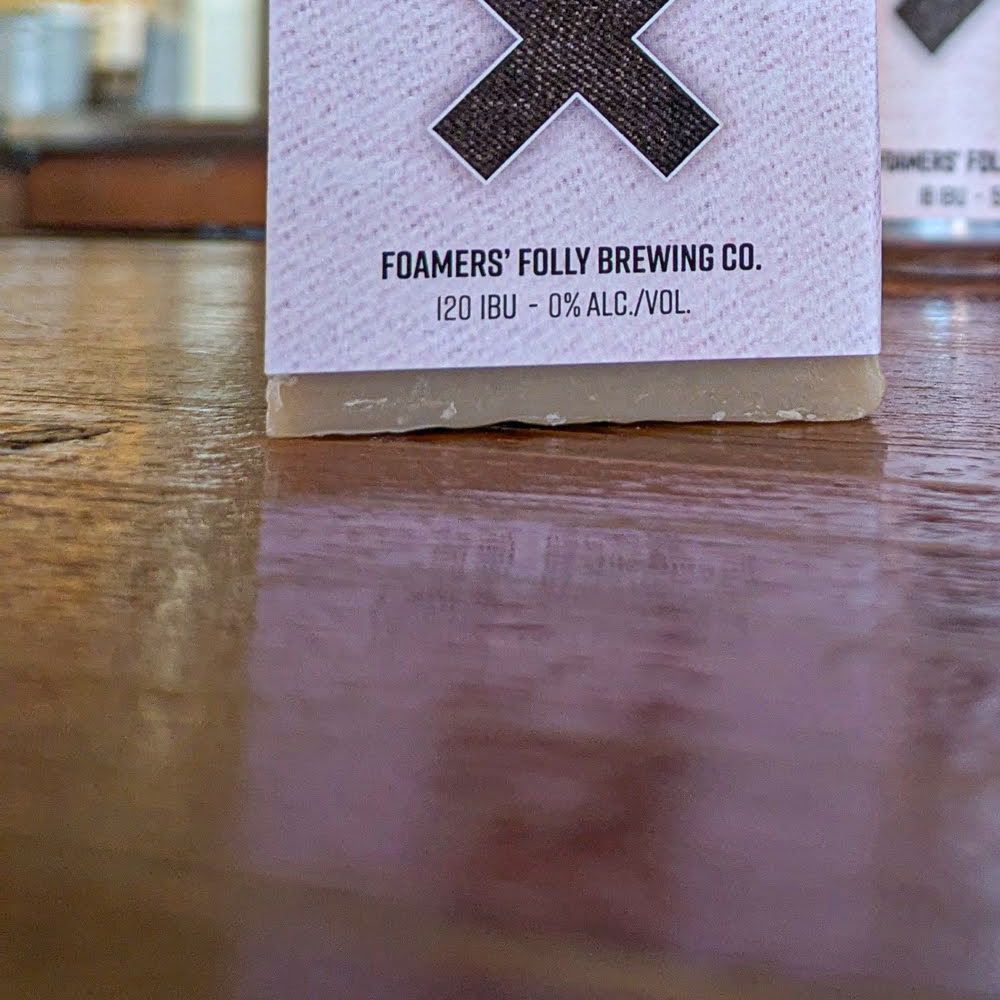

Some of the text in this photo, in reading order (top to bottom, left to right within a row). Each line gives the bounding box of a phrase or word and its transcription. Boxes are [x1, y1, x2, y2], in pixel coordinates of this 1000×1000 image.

[381, 242, 762, 280] FOAMERS' FOLLY BREWING CO.
[436, 294, 471, 322] 120
[480, 293, 517, 320] IBU
[548, 291, 581, 318] 0%
[586, 288, 691, 317] ALC./VOL.
